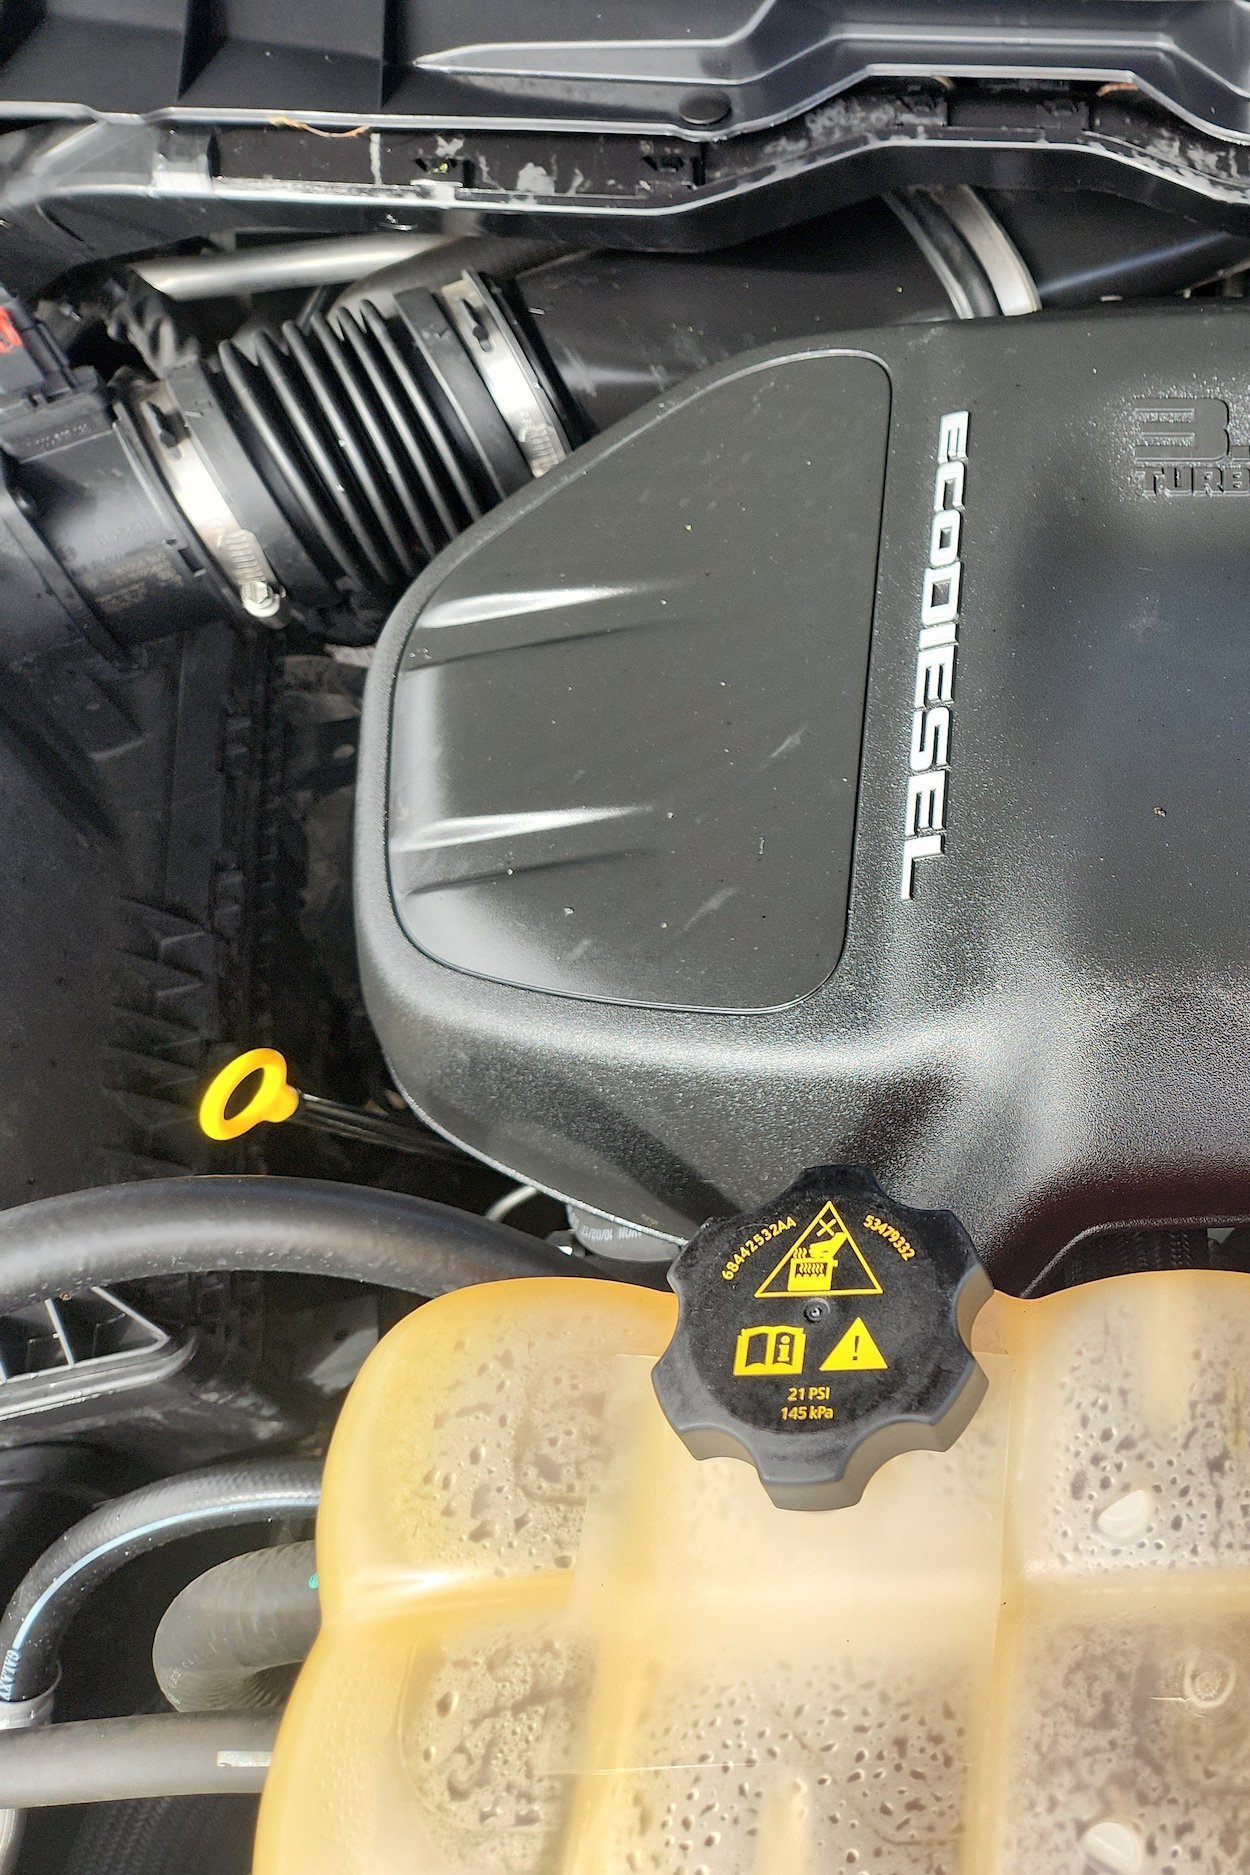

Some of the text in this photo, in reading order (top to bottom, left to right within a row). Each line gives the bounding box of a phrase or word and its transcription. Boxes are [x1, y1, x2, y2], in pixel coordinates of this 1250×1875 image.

[901, 410, 970, 901] ECODIESEL
[721, 1215, 797, 1281] 68442532AA
[862, 1214, 917, 1262] 53479332
[781, 1405, 834, 1420] 145 kPa
[786, 1386, 831, 1401] 21 PSI
